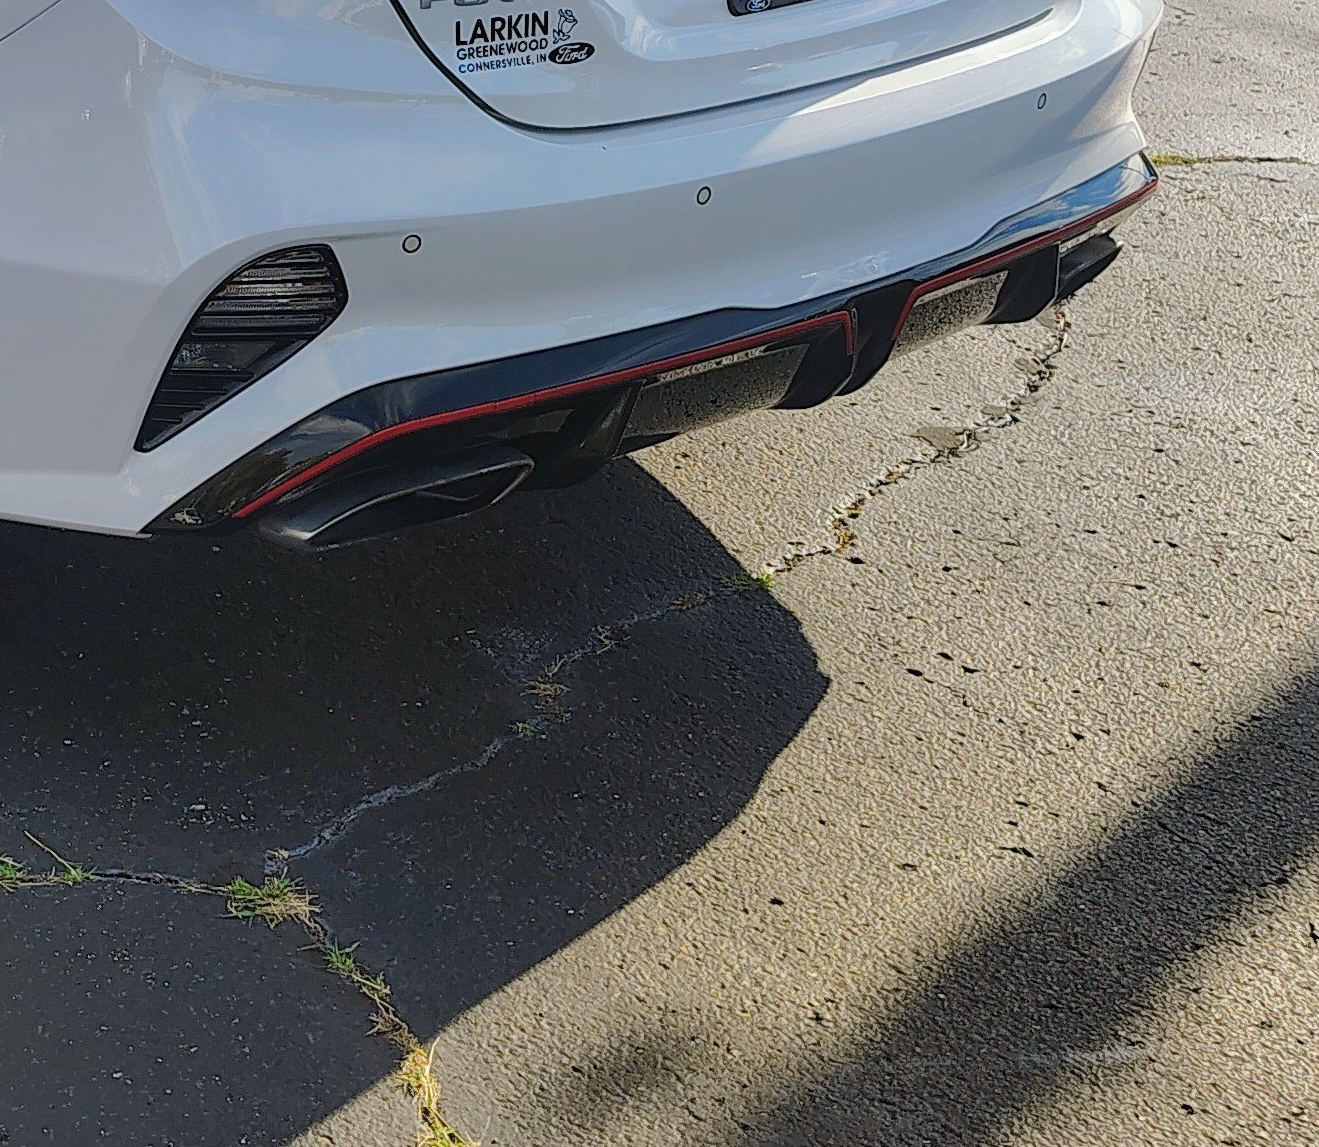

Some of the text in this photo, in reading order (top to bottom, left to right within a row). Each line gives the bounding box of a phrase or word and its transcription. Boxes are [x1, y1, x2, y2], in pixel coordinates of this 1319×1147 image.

[455, 10, 549, 46] LARKIN
[456, 38, 549, 60] GREENEWOOD
[554, 44, 588, 63] Ford
[459, 53, 547, 74] CONNERSVILLE, IN
